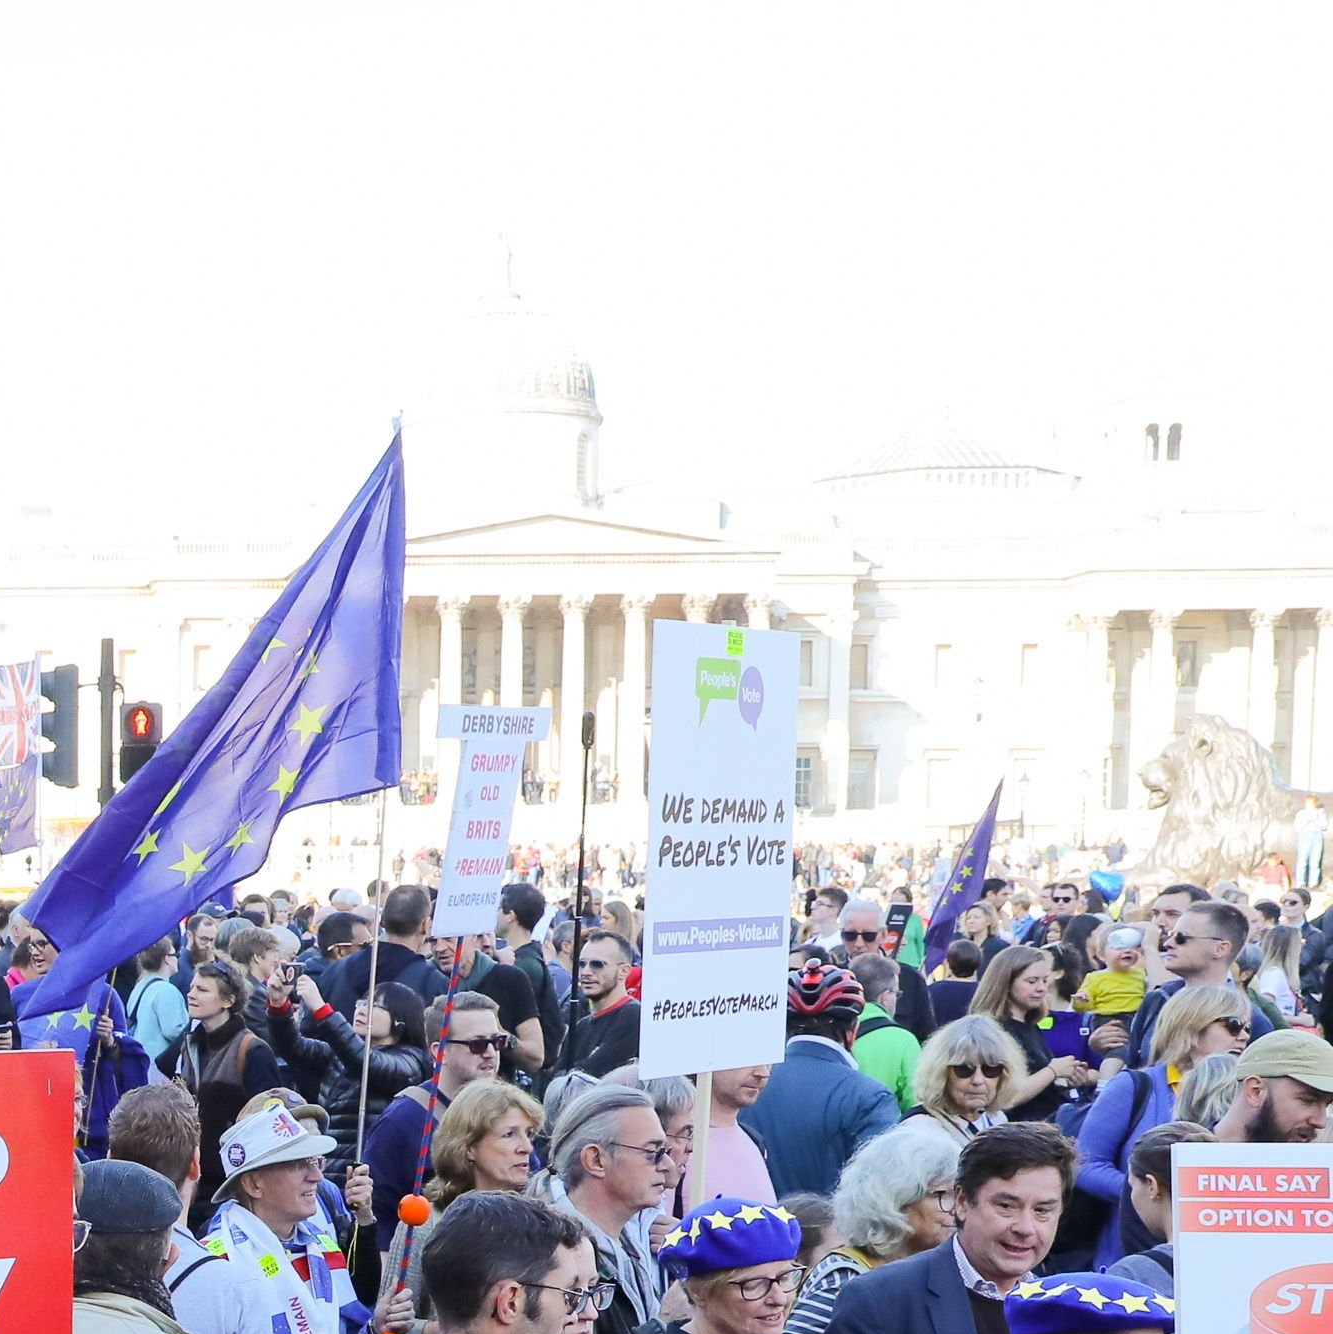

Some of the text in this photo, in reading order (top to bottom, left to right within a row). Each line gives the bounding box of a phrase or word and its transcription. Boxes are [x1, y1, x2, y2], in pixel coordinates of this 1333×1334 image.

[700, 669, 737, 690] People's
[742, 686, 761, 704] Vote
[462, 714, 535, 735] DERBYSHIRE
[471, 754, 518, 773] GRUMPY
[480, 785, 500, 801] OLD
[466, 820, 501, 840] BRITS
[455, 855, 504, 877] #REMAIN
[447, 892, 498, 908] EUROPEANS
[657, 922, 780, 948] www.Peoples-Vote.uk
[1197, 1174, 1322, 1192] FINAL SAY
[1198, 1208, 1333, 1227] OPTION TO
